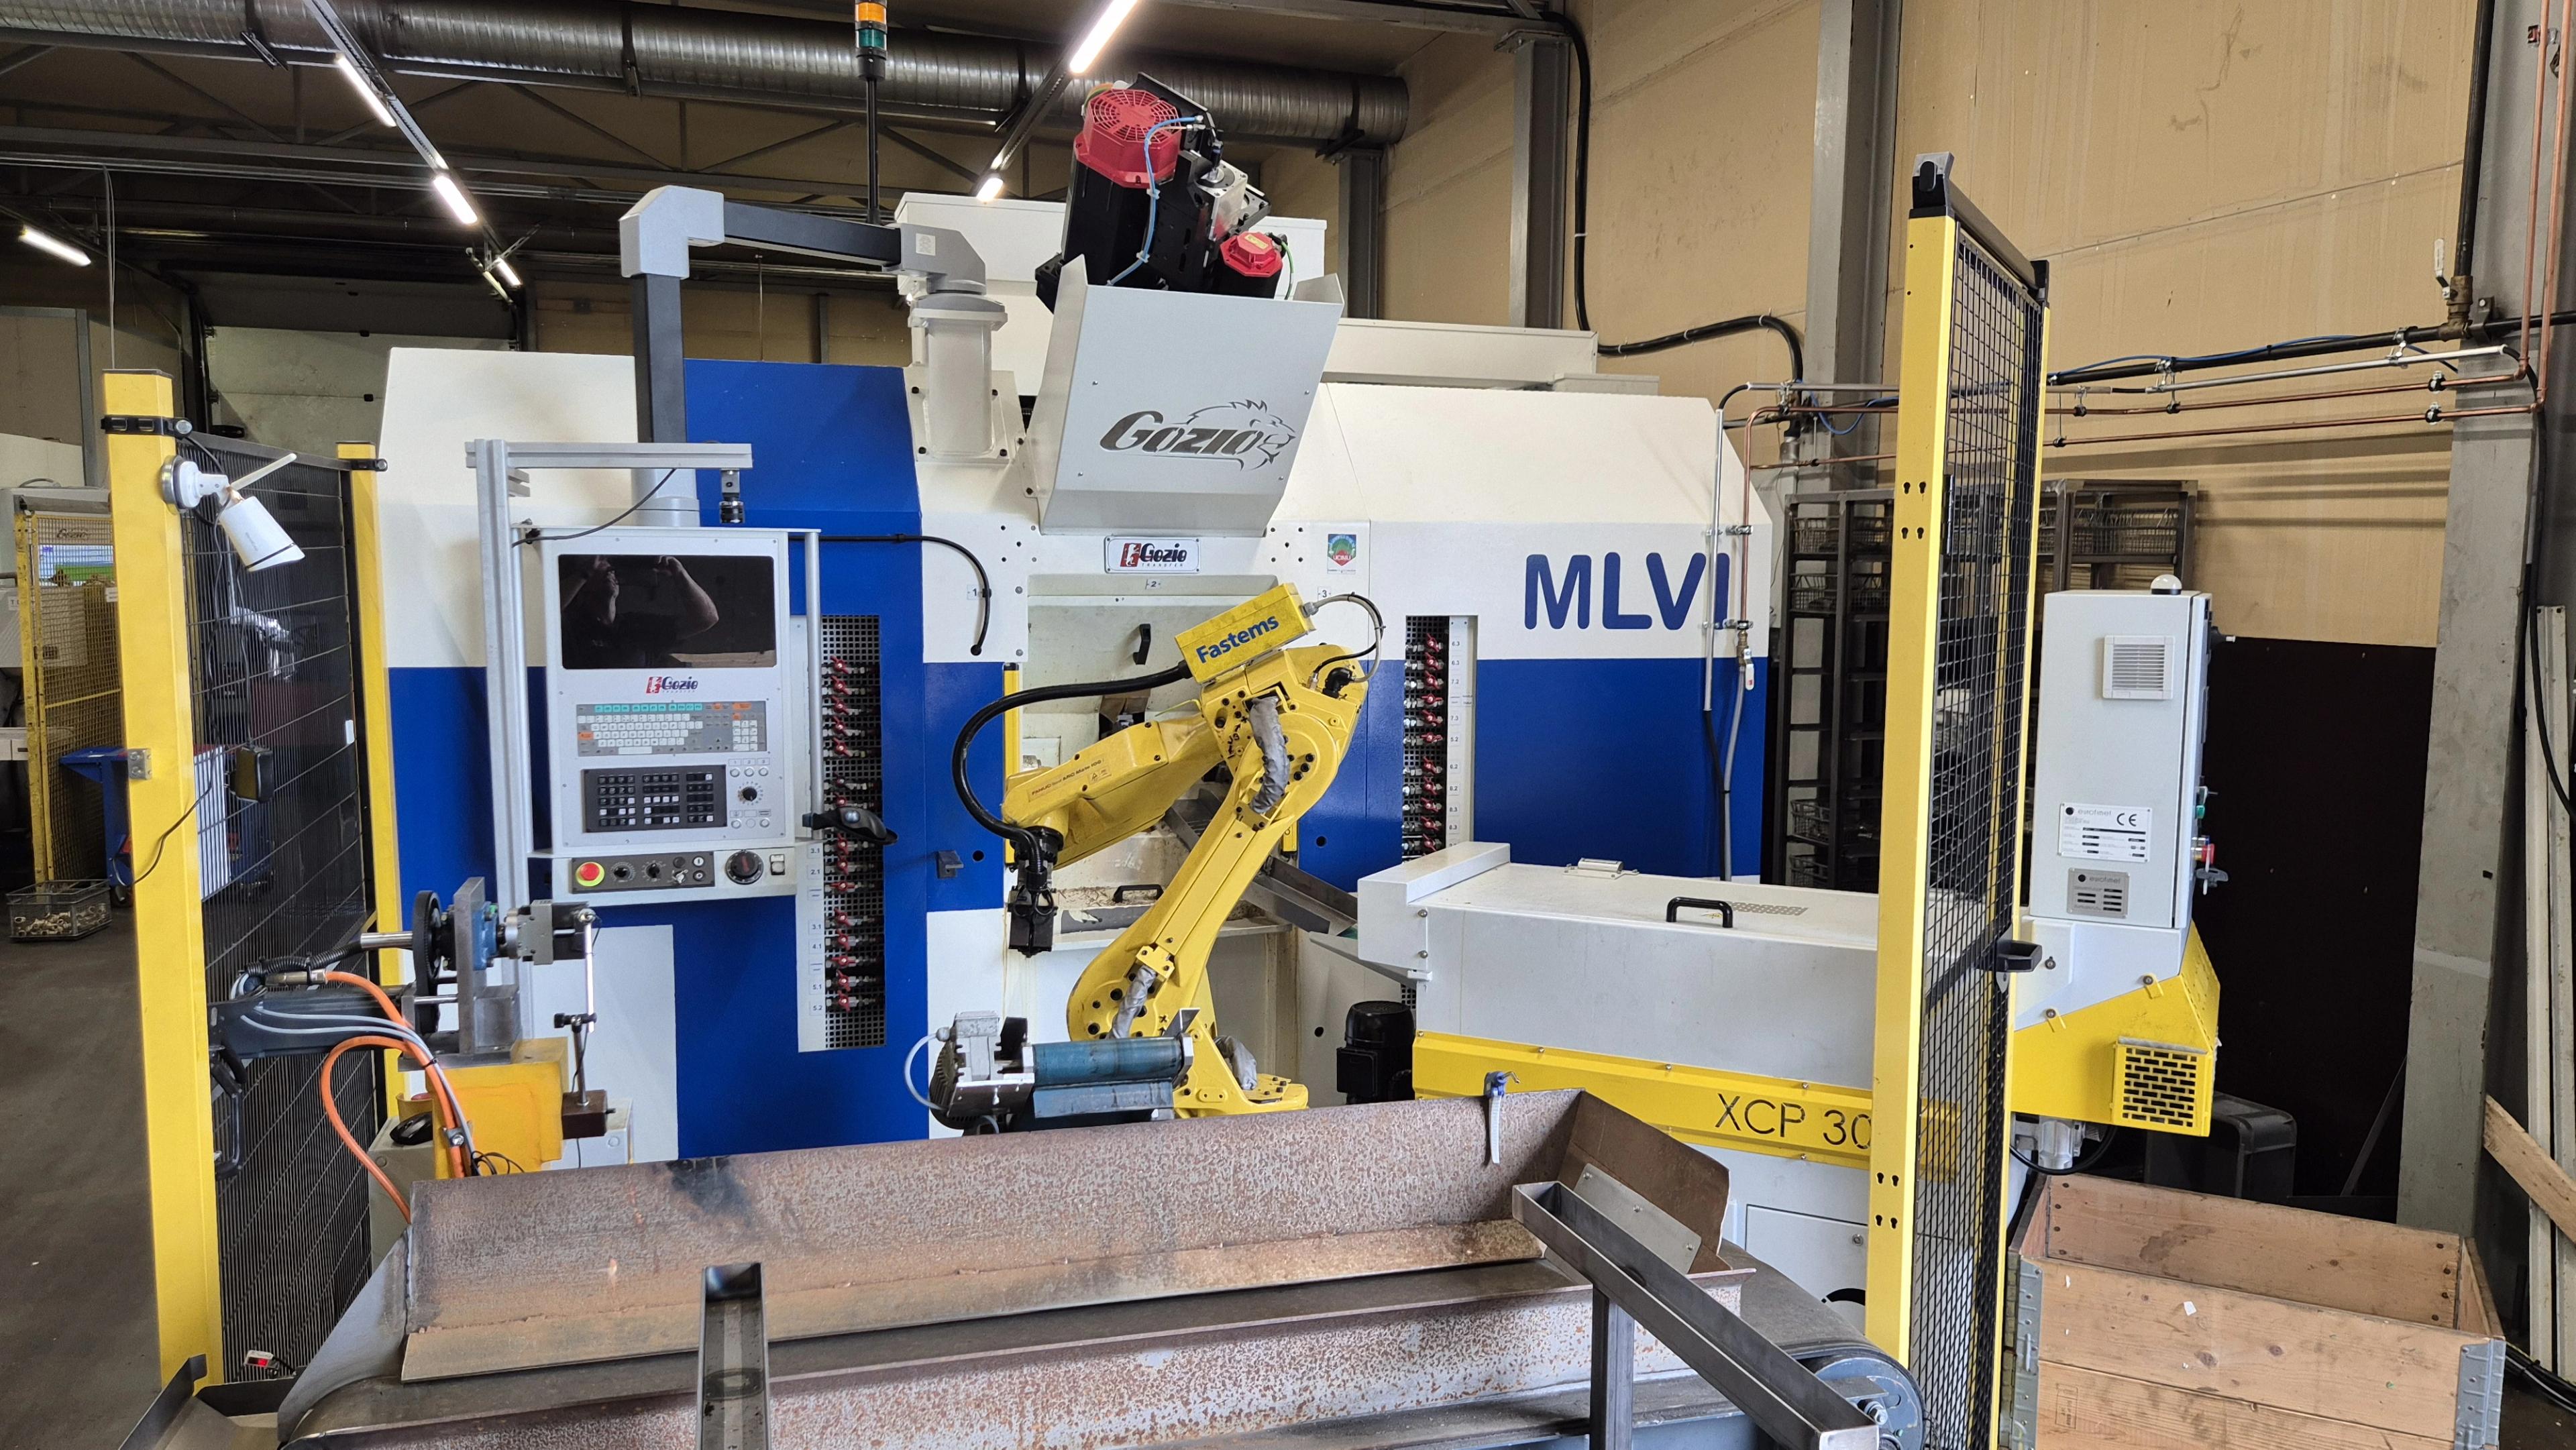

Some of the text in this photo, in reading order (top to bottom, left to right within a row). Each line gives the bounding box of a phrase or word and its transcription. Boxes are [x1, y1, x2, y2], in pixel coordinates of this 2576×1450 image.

[1140, 543, 1187, 563] Gozio
[1524, 551, 1730, 630] MLVI
[1196, 615, 1280, 664] Fastems
[1715, 1093, 1806, 1137] XCP
